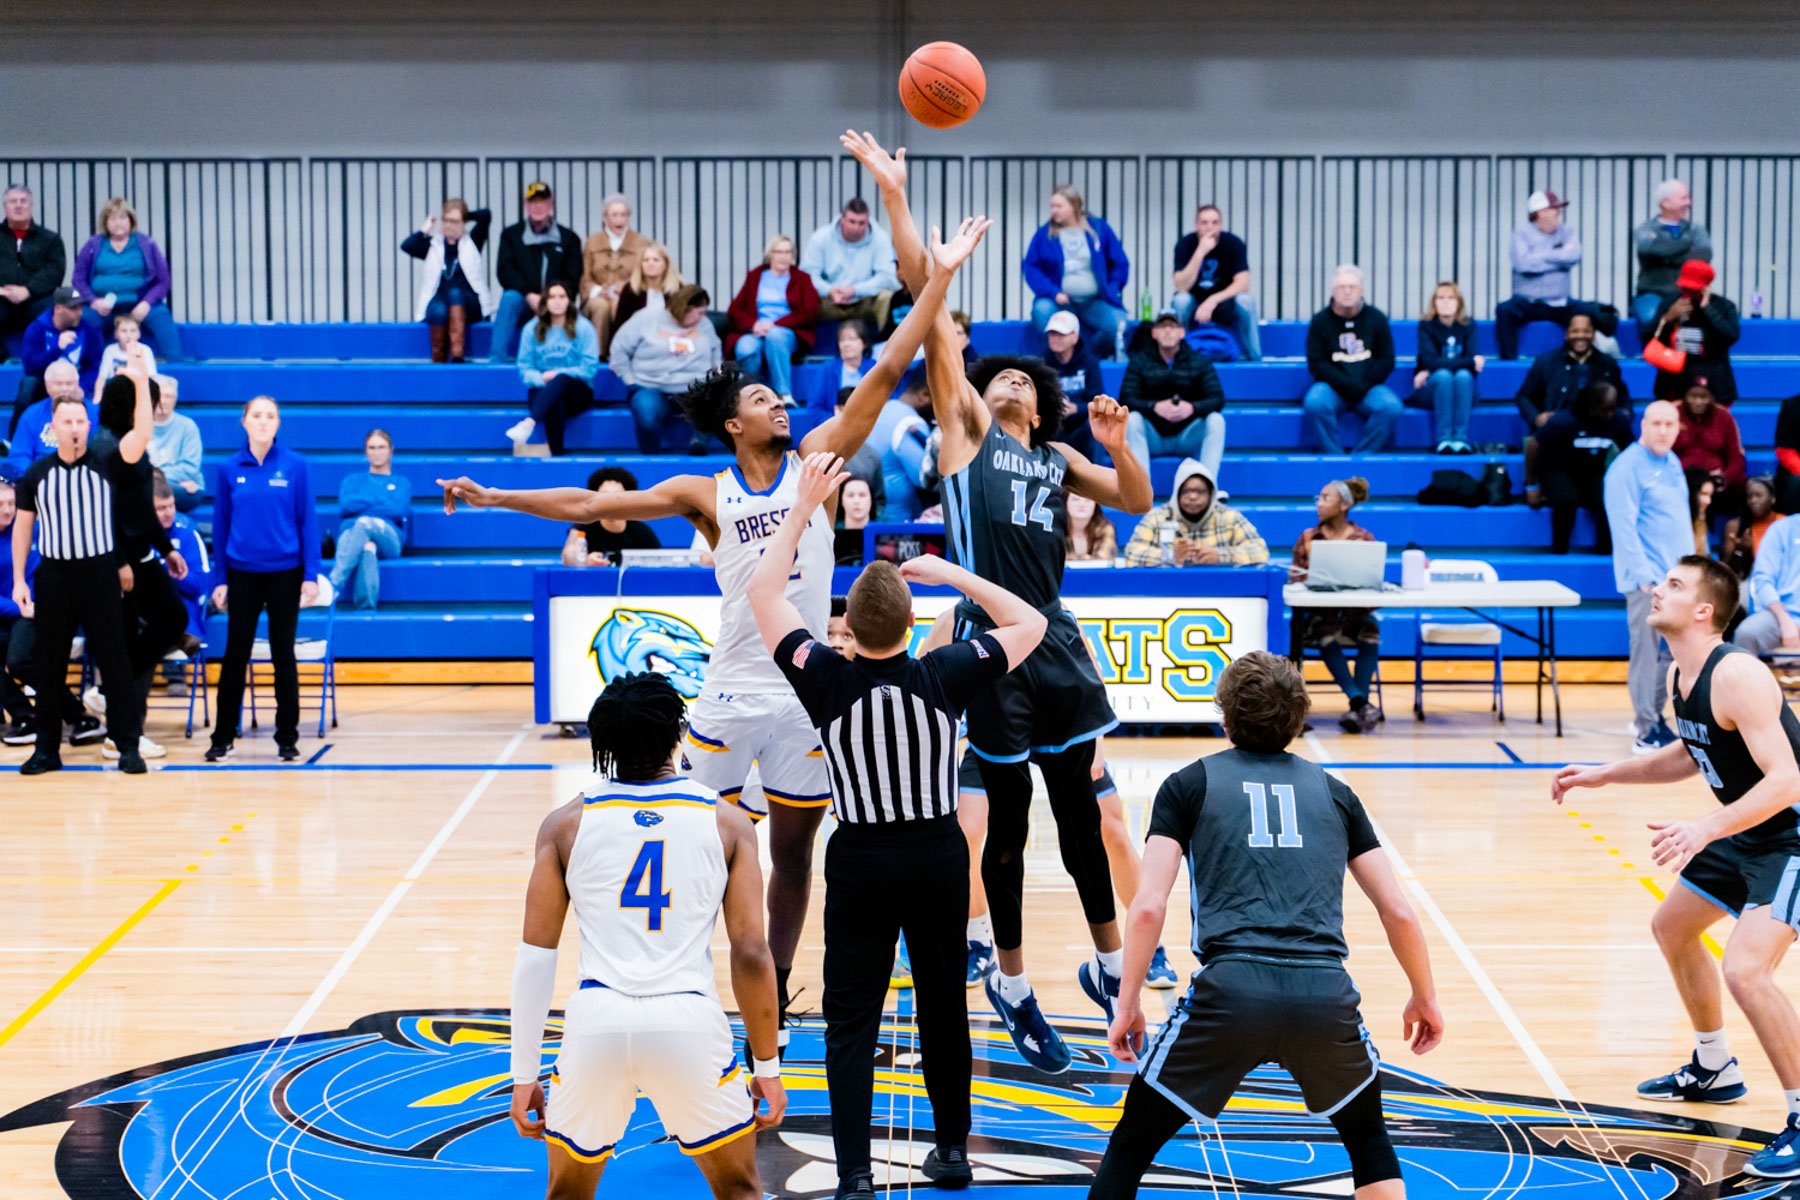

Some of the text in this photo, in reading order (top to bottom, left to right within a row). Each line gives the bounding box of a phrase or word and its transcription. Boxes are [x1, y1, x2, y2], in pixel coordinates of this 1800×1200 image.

[925, 83, 967, 113] LEGACY
[993, 450, 1048, 479] OAKLAND
[1011, 479, 1054, 532] 14
[1243, 781, 1303, 848] 11
[618, 838, 672, 932] 4
